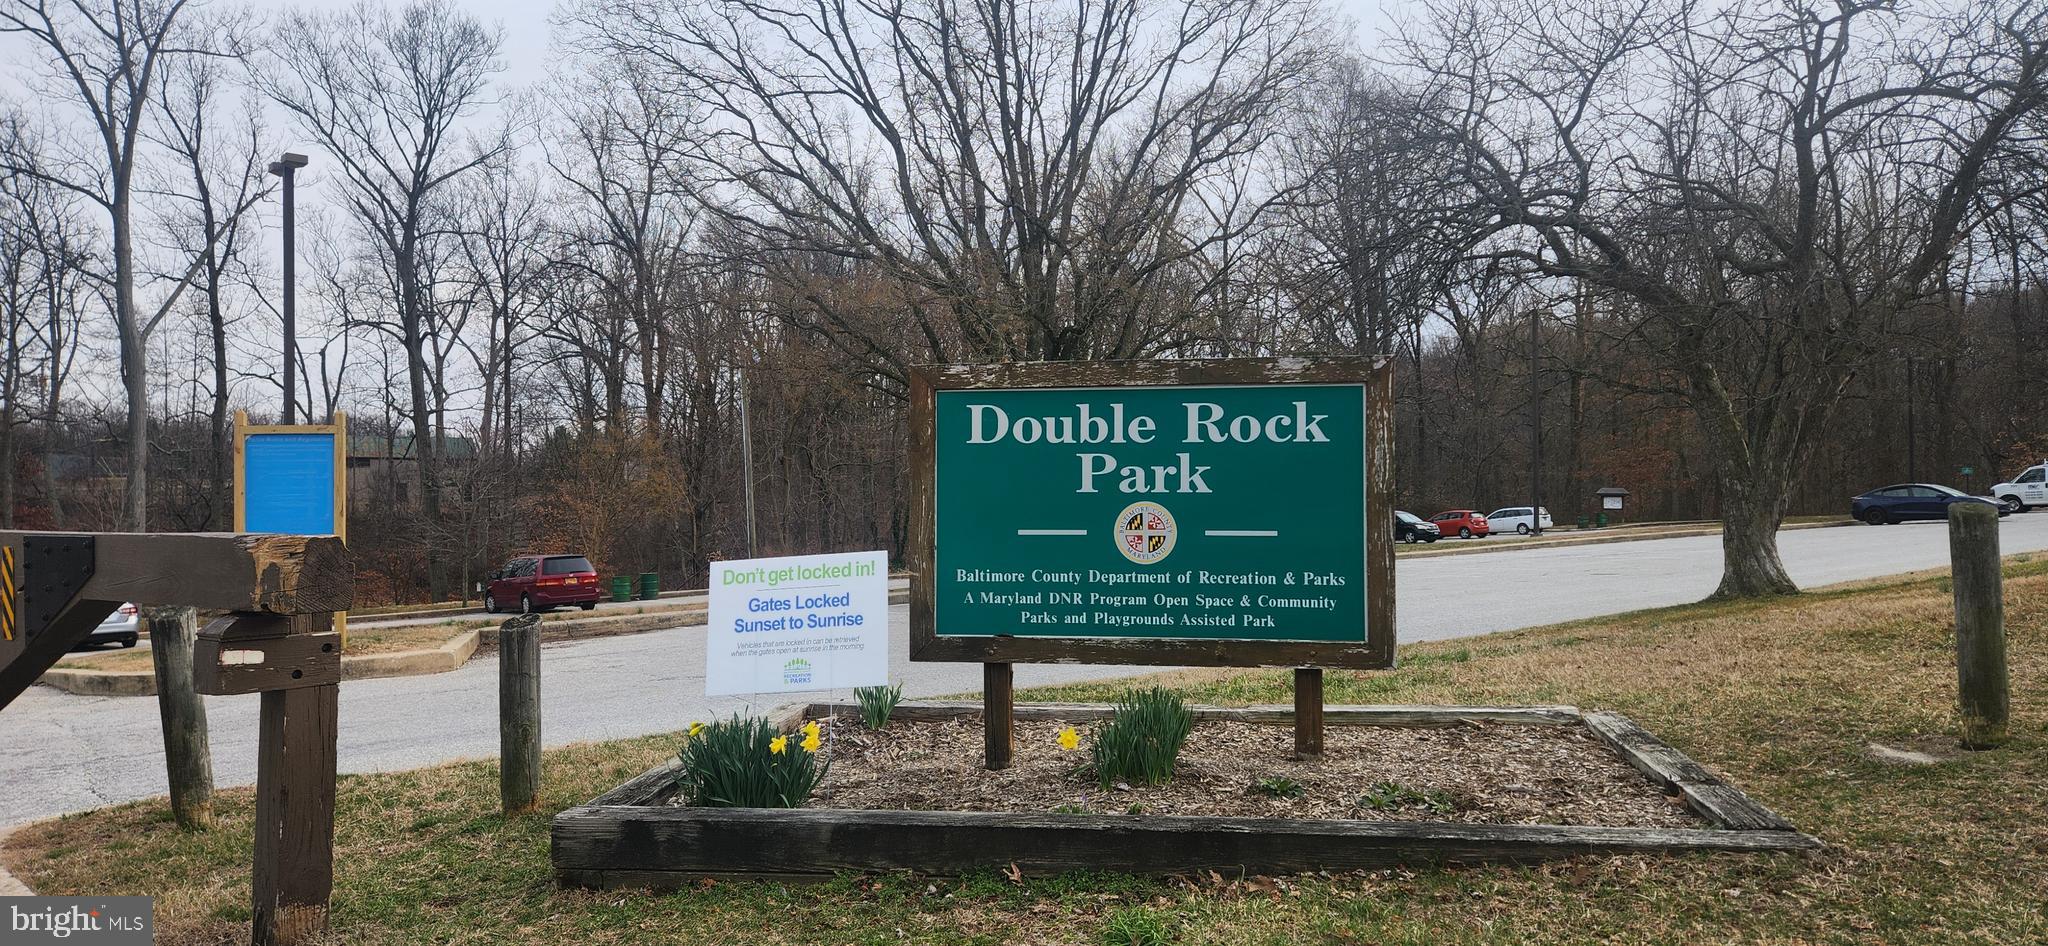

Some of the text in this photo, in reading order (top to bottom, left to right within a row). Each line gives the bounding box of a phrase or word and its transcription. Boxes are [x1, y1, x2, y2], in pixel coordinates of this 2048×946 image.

[967, 402, 1329, 443] Double Rock
[1077, 453, 1212, 492] Park
[1120, 506, 1173, 534] BALTIMORE COUNTY
[1127, 547, 1166, 560] MARYLAND
[723, 560, 875, 586] Don't get locked in!
[957, 569, 1345, 586] Baltimore County Department of Recreation & Parks
[749, 592, 850, 612] Gates Locked
[964, 591, 1337, 611] A Maryland DNR Program Open Space & Community
[734, 612, 864, 633] Sunset to Sunrise
[1021, 611, 1275, 627] Parks and Playgrounds Assisted Park
[731, 649, 748, 657] when
[758, 648, 775, 656] gates
[762, 640, 774, 648] that
[786, 638, 805, 647] locked
[806, 638, 812, 646] in
